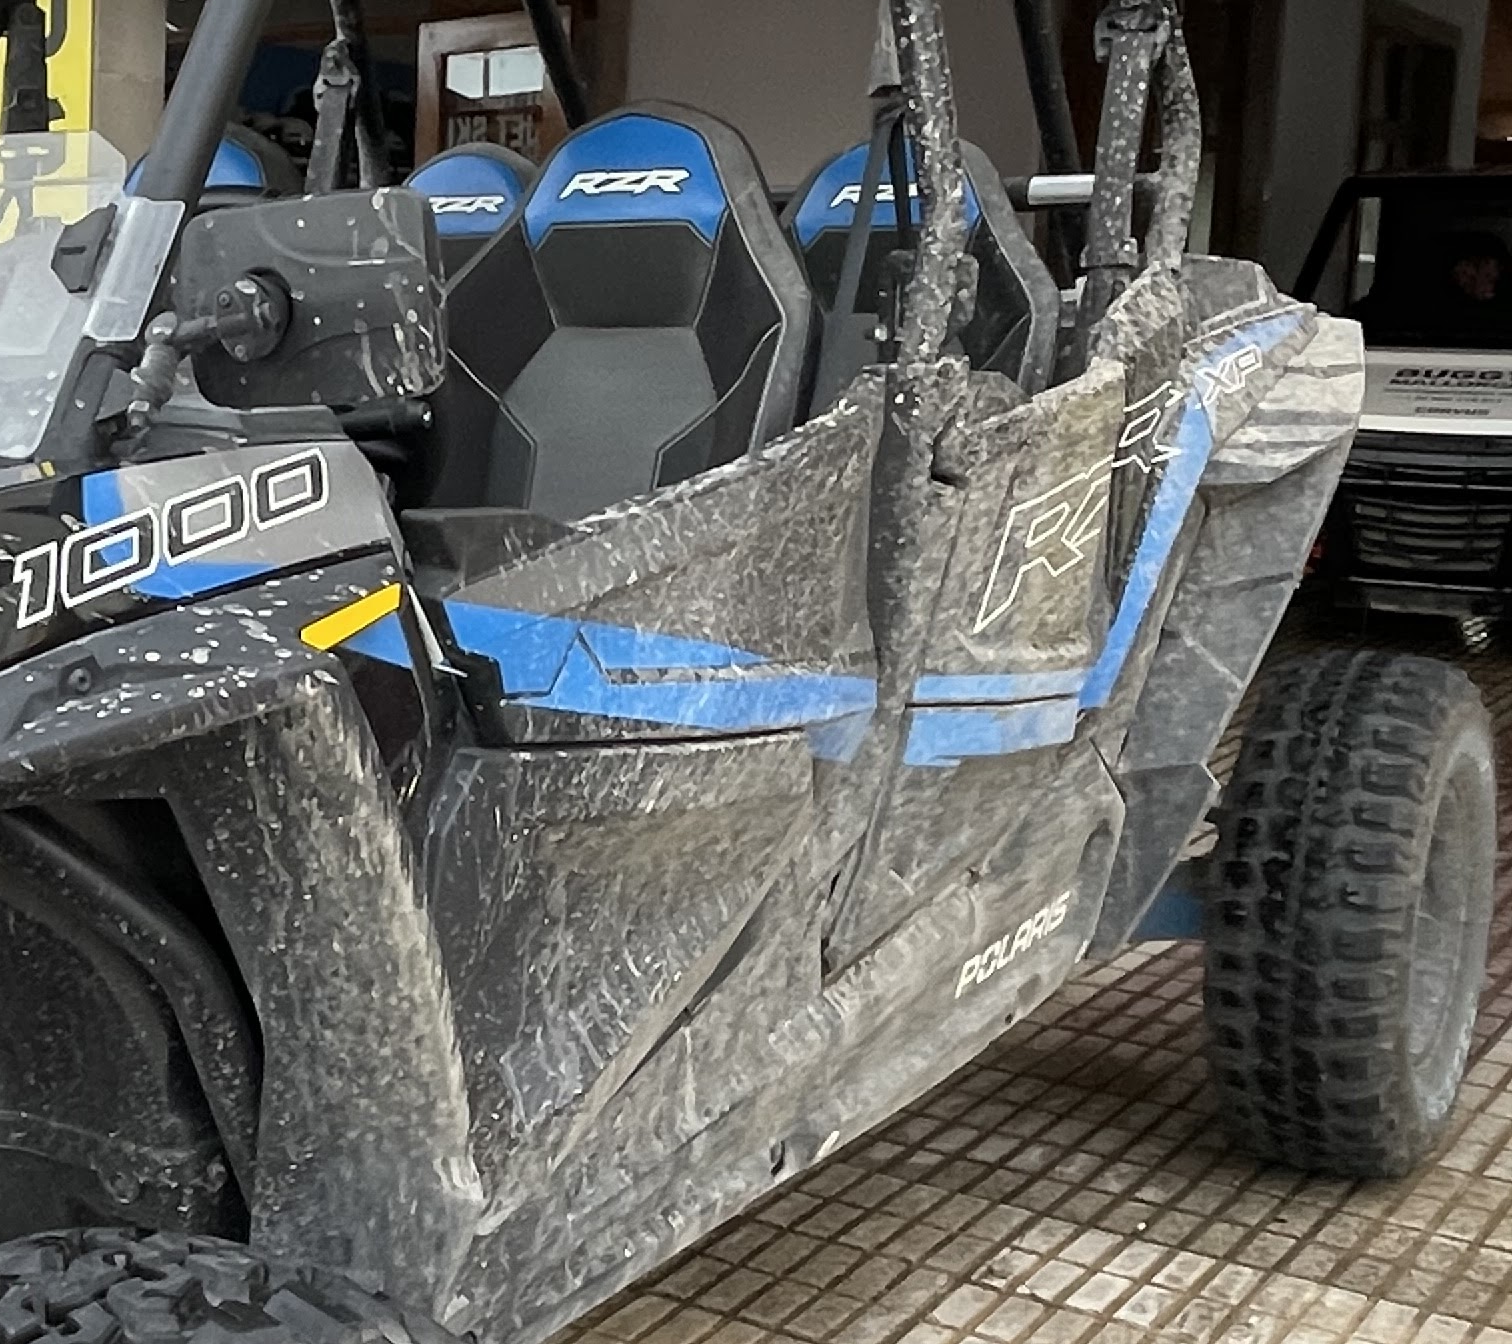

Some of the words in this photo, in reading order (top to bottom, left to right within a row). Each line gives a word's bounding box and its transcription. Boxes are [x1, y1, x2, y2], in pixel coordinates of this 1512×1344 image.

[558, 169, 691, 200] RZR
[12, 446, 330, 631] 1000
[954, 890, 1071, 999] POLARIS
